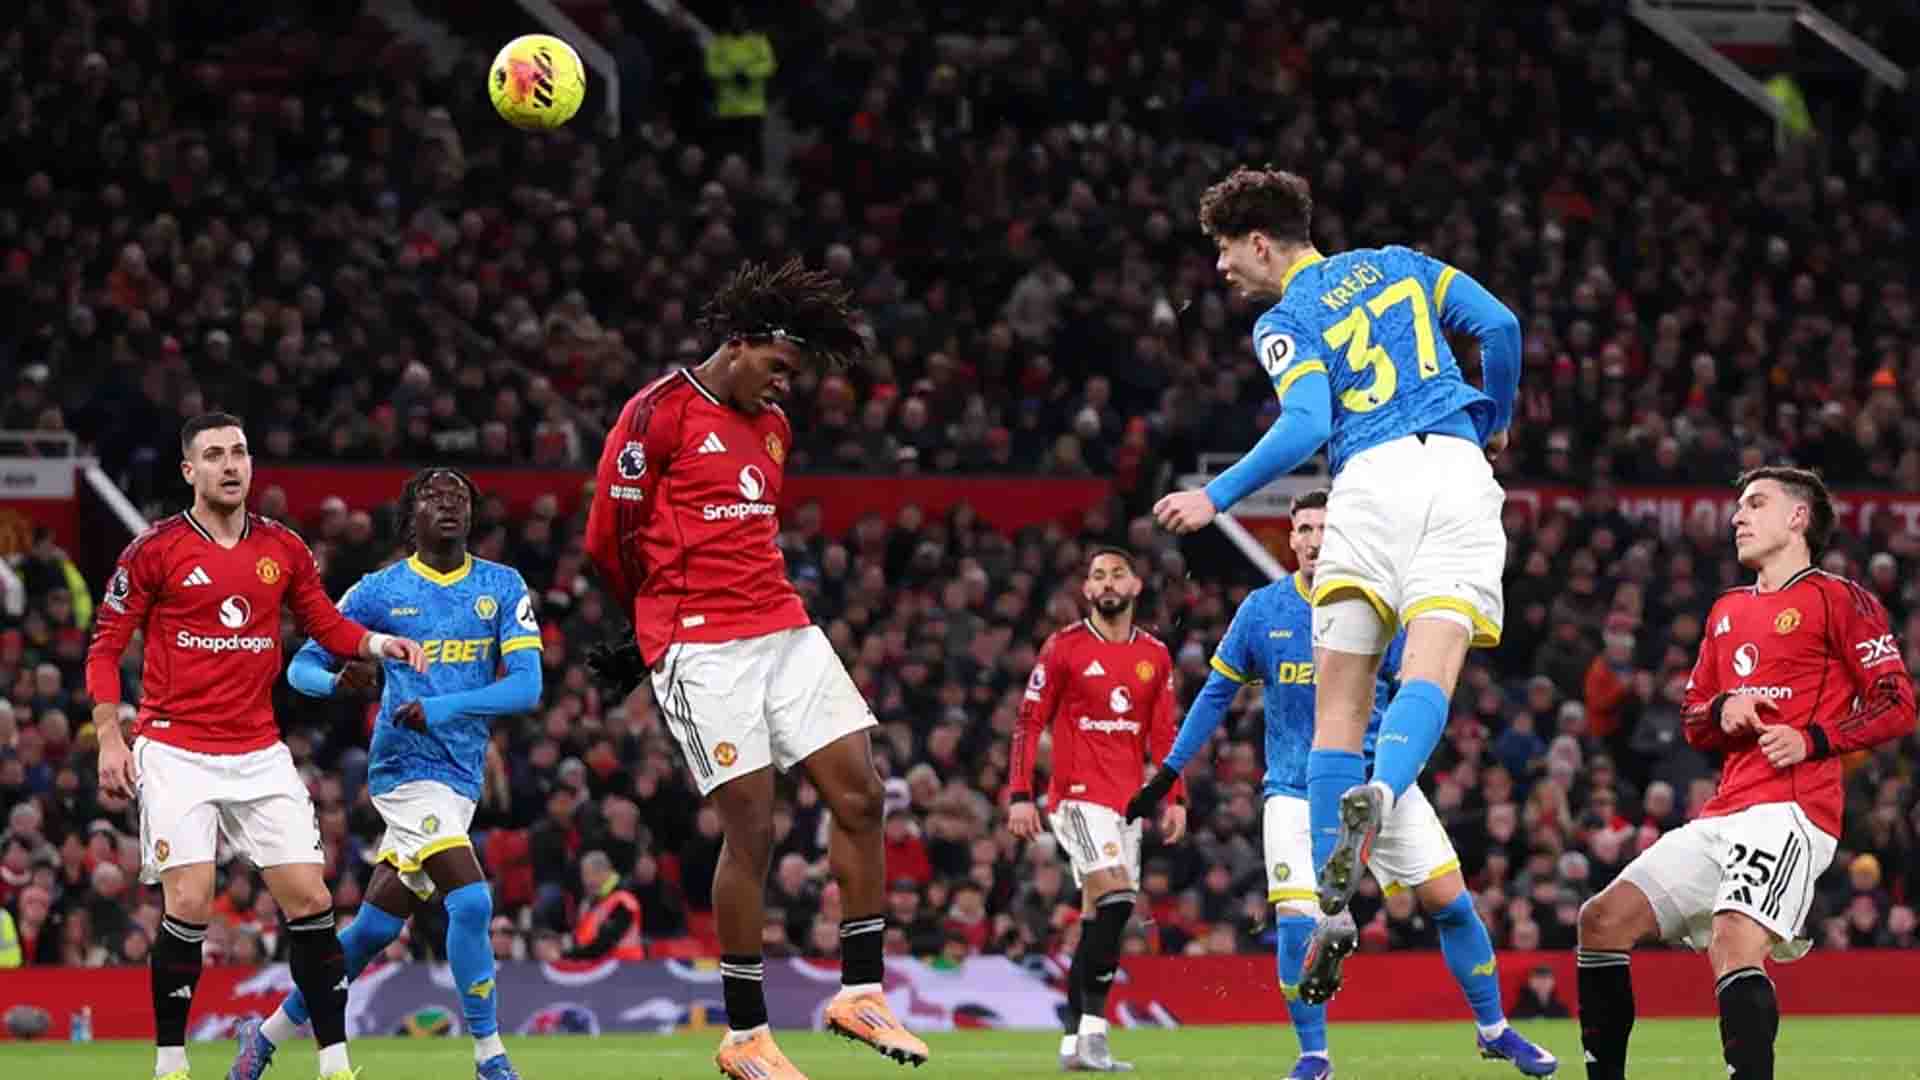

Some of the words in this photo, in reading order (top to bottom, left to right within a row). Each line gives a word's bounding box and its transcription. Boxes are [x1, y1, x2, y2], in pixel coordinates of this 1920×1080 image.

[1266, 338, 1289, 370] JD
[1322, 276, 1440, 413] 37
[422, 637, 495, 664] EBET
[1856, 632, 1898, 663] DXC
[1722, 843, 1777, 887] 25
